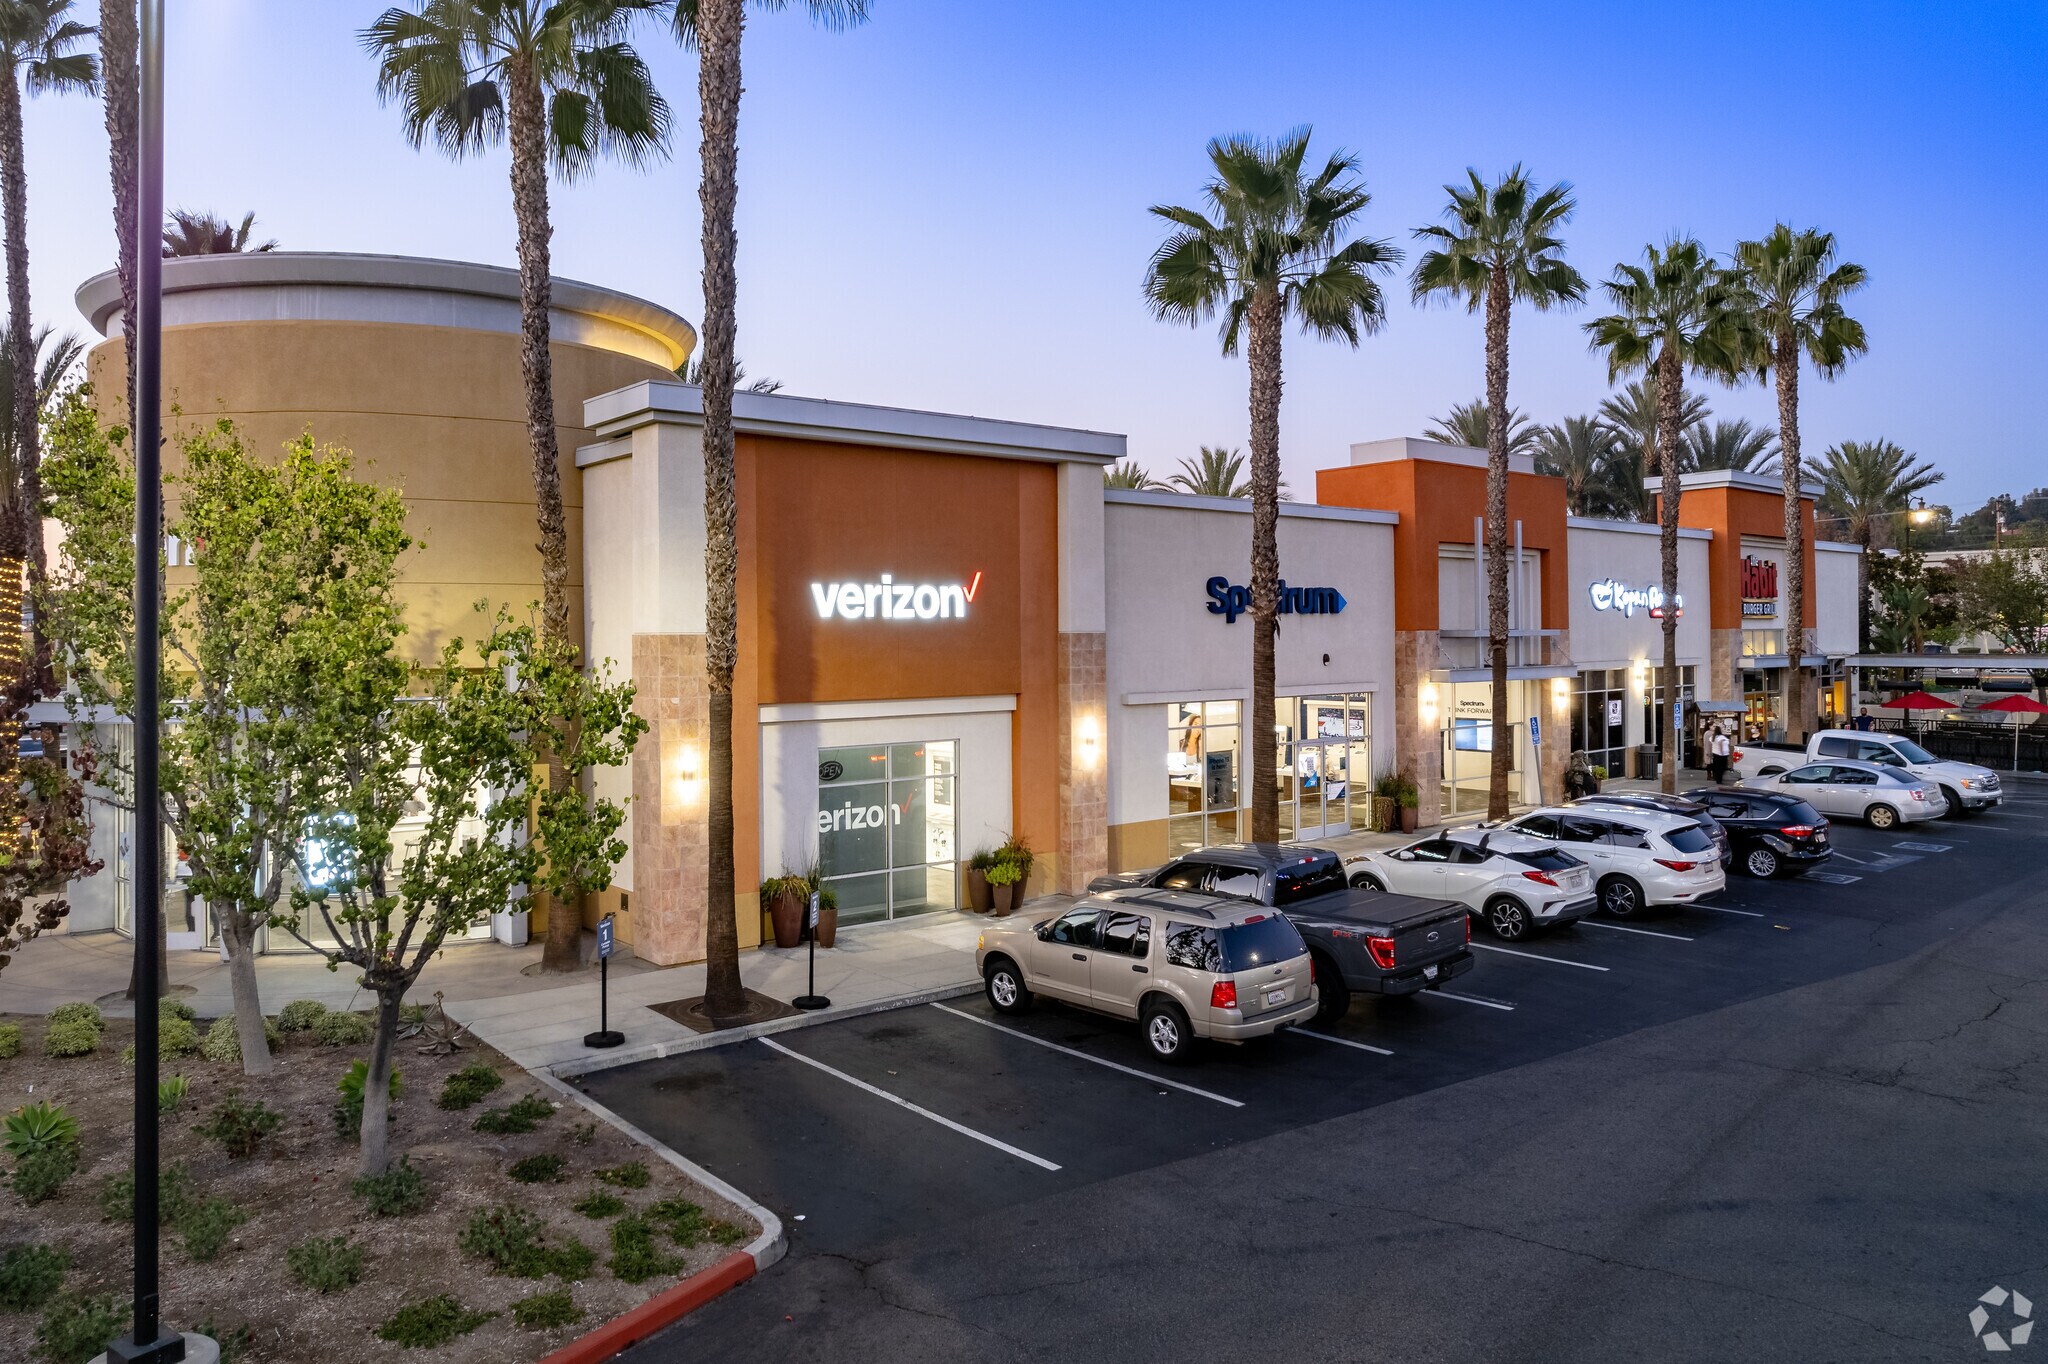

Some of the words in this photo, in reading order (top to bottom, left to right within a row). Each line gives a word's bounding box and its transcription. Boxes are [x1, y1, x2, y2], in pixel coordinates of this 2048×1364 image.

[1741, 559, 1778, 598] Habit
[811, 574, 965, 619] verizon
[1206, 576, 1341, 623] Sptrum
[1743, 603, 1763, 615] BURGER
[1763, 603, 1777, 615] GRILL
[819, 763, 841, 778] OPEN
[818, 801, 901, 834] erizon
[602, 929, 608, 941] 1
